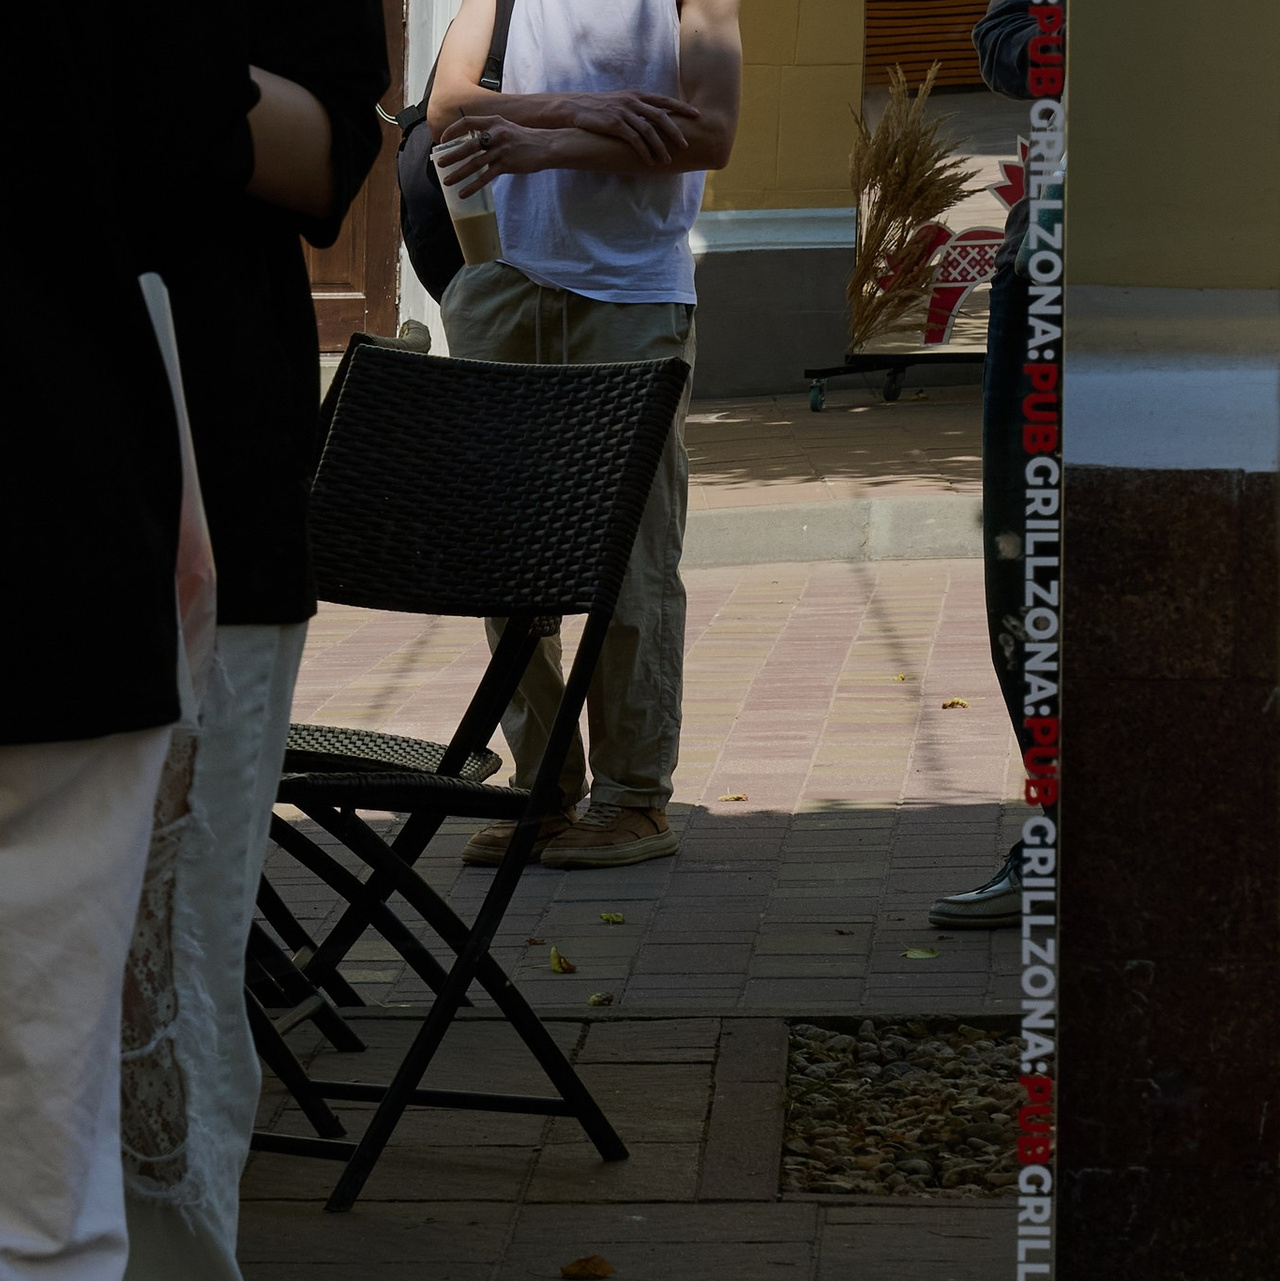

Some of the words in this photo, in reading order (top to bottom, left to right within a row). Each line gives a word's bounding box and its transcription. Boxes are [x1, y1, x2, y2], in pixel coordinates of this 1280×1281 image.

[1023, 98, 1067, 455] GRILLZONA:PUB
[1021, 456, 1064, 806] GRILLZONA:PUB
[1017, 815, 1059, 1164] GRILLZONA:PUB
